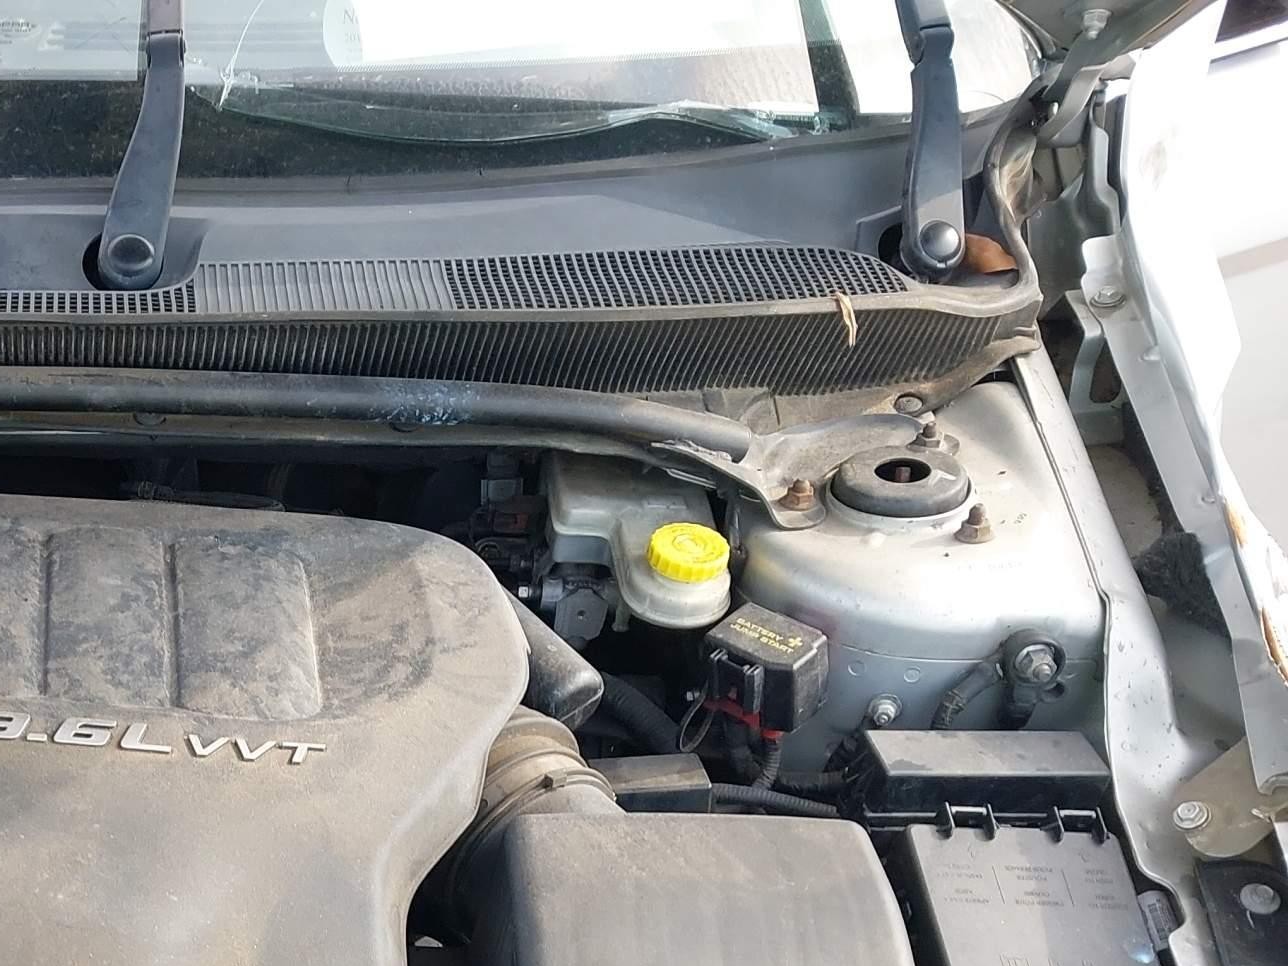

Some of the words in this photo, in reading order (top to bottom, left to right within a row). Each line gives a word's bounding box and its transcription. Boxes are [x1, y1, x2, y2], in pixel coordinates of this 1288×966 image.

[730, 623, 760, 639] JUMP
[760, 636, 794, 654] START
[736, 617, 785, 641] BATTERY
[184, 733, 327, 765] VVT
